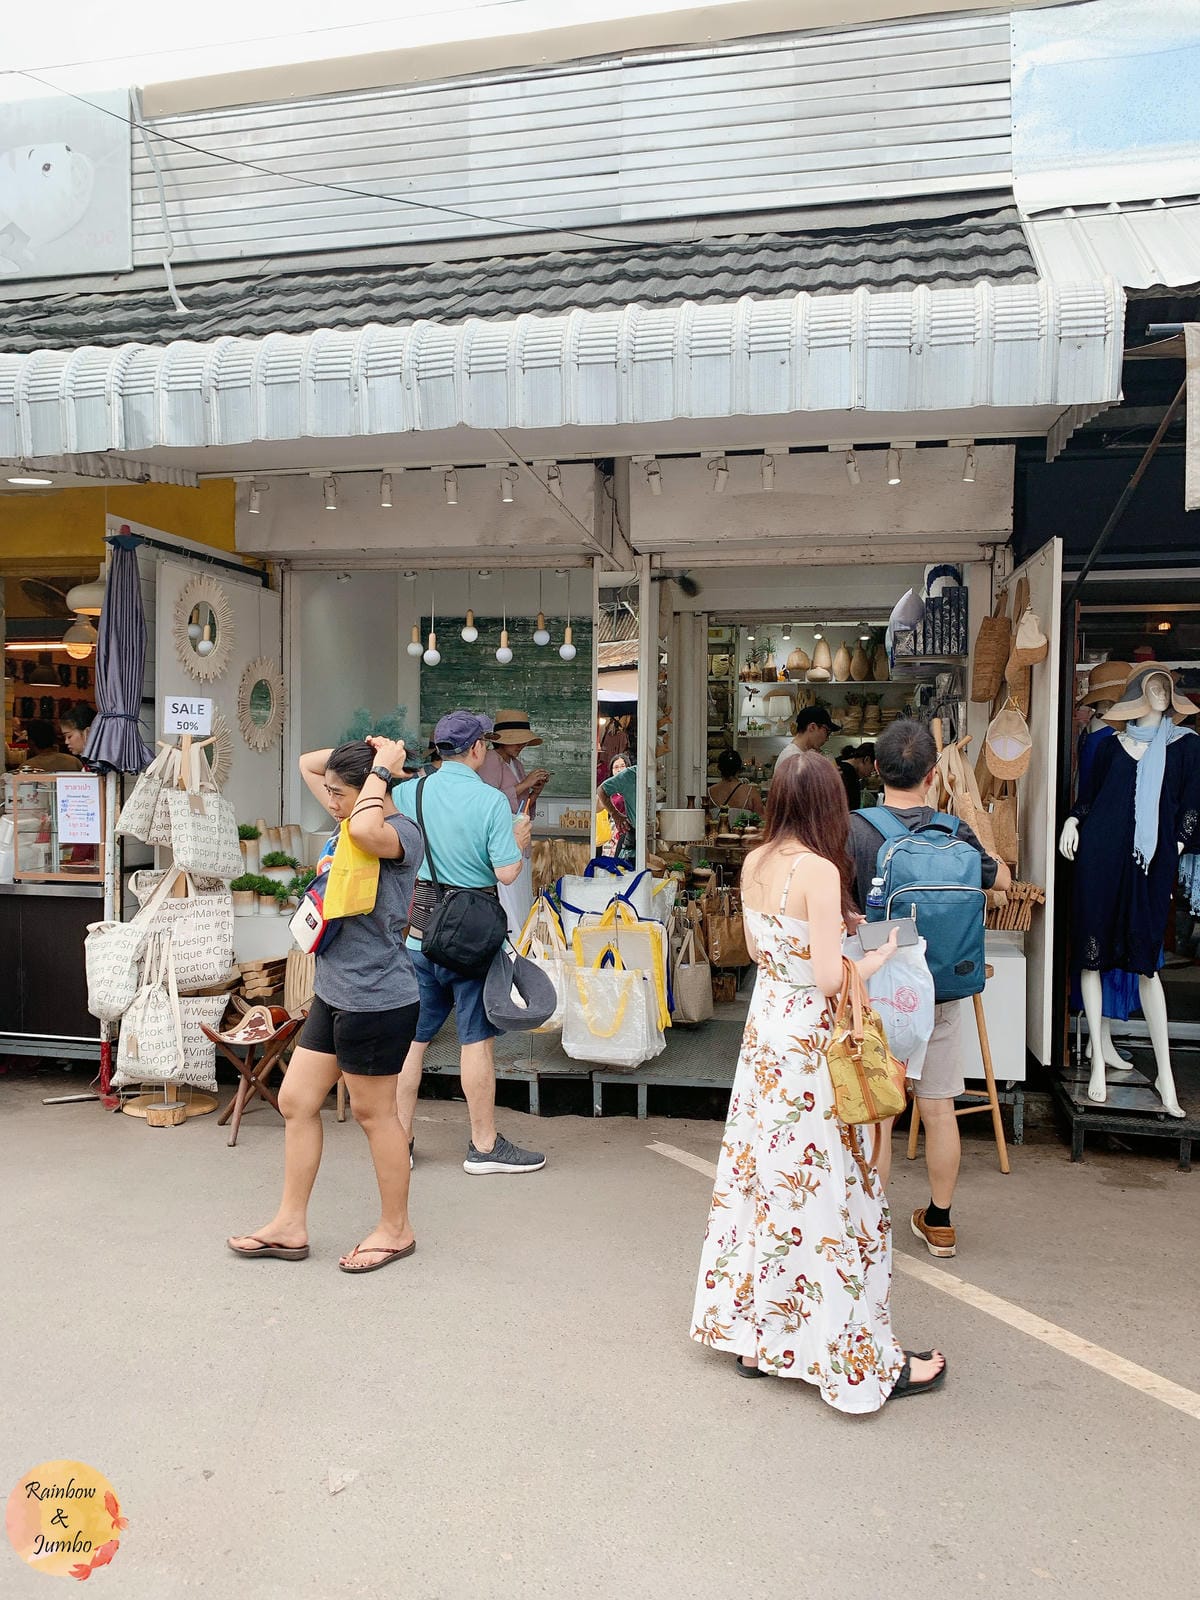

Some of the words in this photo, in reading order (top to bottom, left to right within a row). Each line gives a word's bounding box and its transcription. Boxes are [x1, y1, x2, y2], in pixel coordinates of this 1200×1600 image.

[171, 703, 205, 715] SALE
[176, 721, 199, 731] 50%
[161, 897, 214, 911] Decoration
